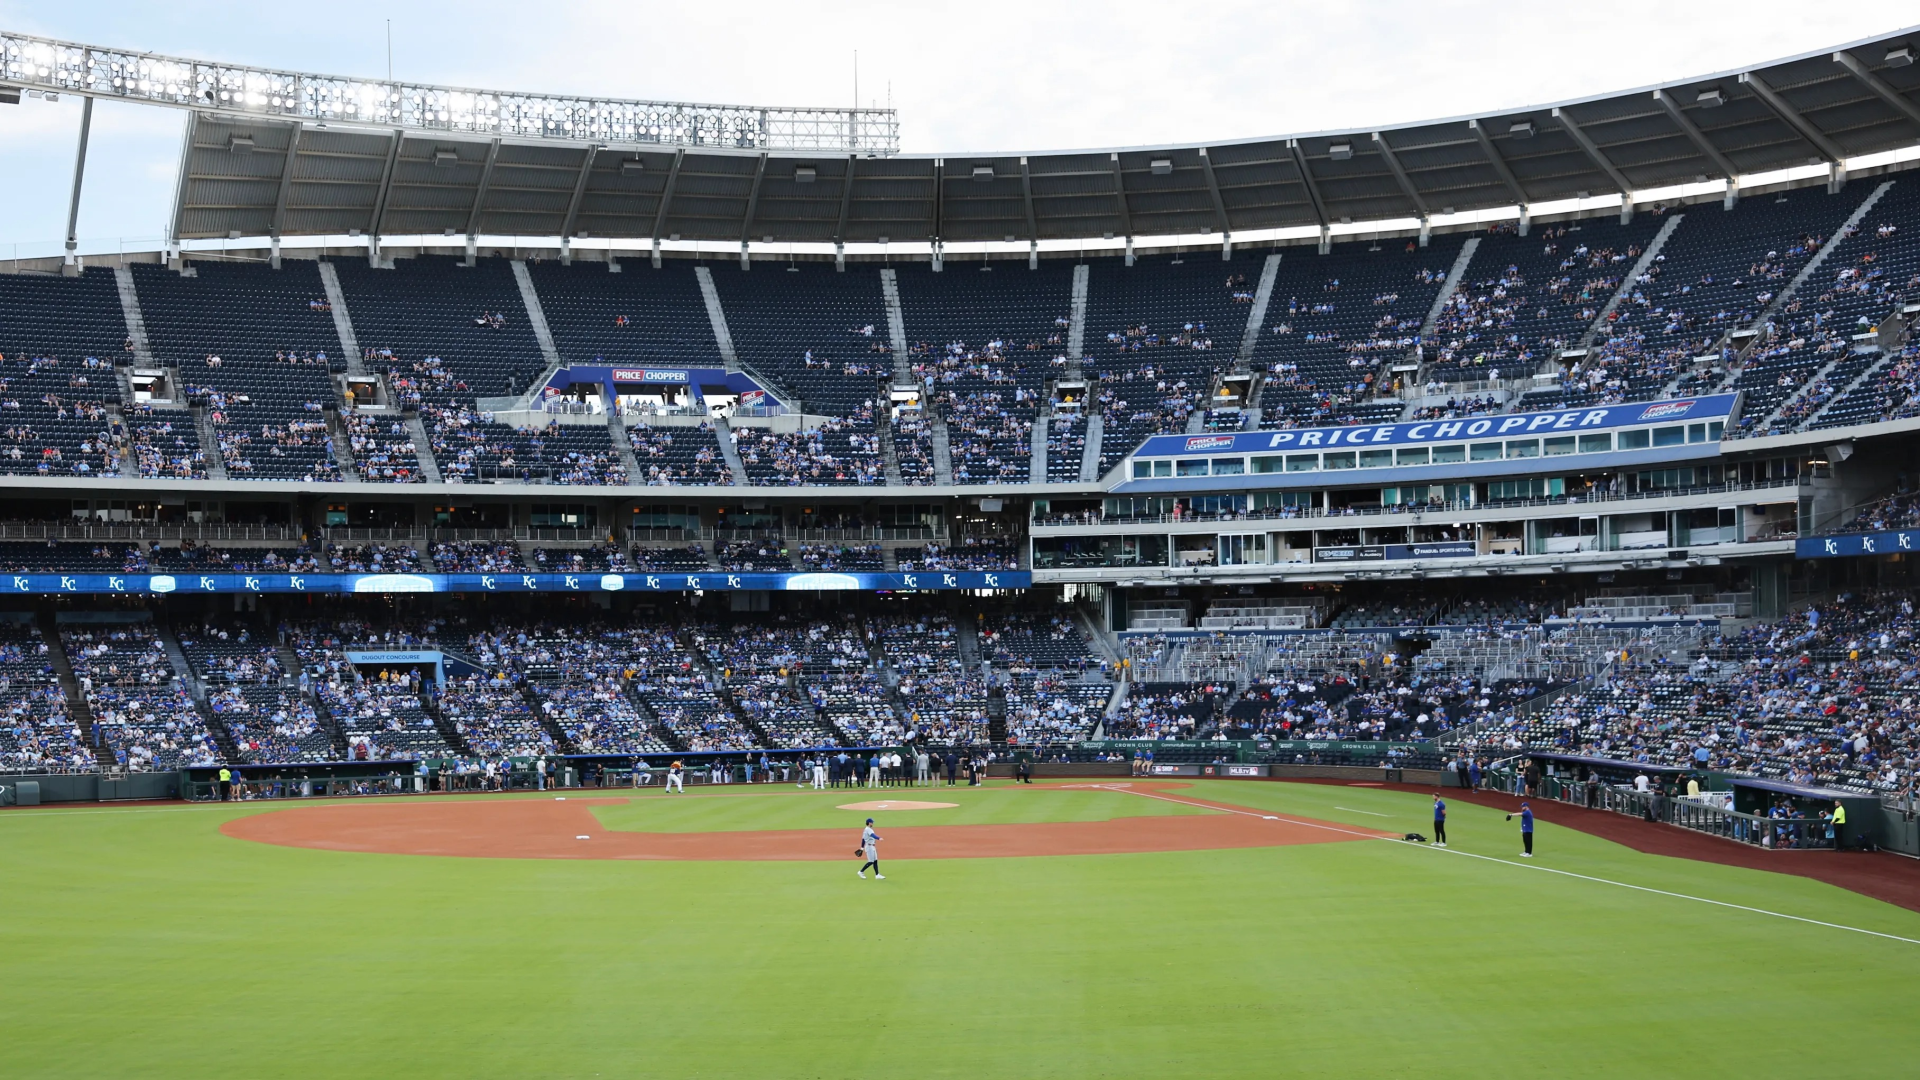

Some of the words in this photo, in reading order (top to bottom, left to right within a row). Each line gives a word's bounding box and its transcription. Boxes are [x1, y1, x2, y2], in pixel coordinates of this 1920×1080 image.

[616, 371, 641, 379] PRICE
[645, 372, 686, 381] CHOPPER
[742, 392, 755, 403] PRICE
[1641, 406, 1689, 419] CHOPPER
[1648, 403, 1677, 413] PRICE
[1268, 427, 1396, 448] PRICE
[1406, 409, 1610, 440] CHOPPER
[1187, 440, 1232, 450] CHOPPER
[1190, 437, 1217, 446] PRICE
[1825, 539, 1838, 554] KC
[1862, 537, 1875, 552] KC
[1899, 533, 1911, 549] KC
[14, 577, 29, 591] KC
[61, 576, 76, 591] KC
[109, 576, 124, 591] KC
[201, 576, 215, 591] KC
[245, 576, 260, 590] KC
[291, 576, 305, 590] KC
[482, 576, 496, 590] KC
[523, 576, 537, 589] KC
[566, 576, 580, 589] KC
[647, 576, 661, 589] KC
[687, 576, 701, 589] KC
[728, 575, 741, 588] KC
[904, 574, 917, 587] KC
[944, 574, 957, 587] KC
[985, 574, 999, 587] KC
